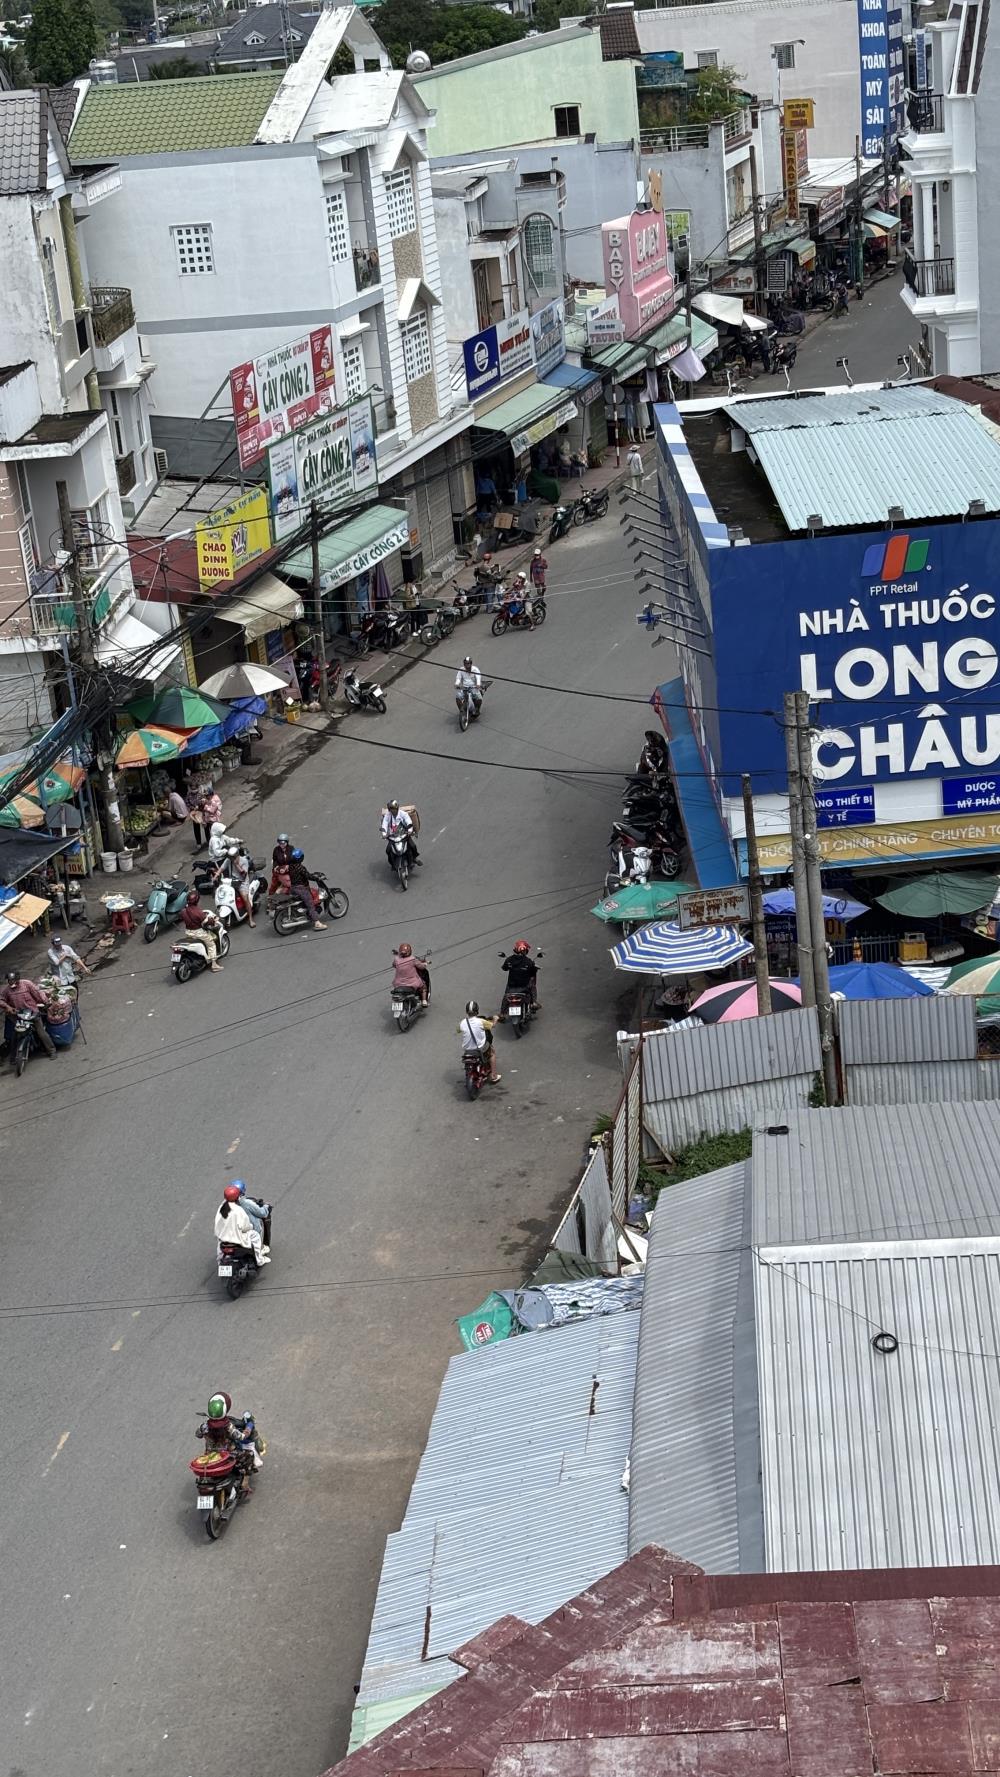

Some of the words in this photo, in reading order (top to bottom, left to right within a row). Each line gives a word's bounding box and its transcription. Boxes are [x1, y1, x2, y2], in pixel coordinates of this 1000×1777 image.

[861, 22, 885, 37] KHOA
[866, 105, 884, 125] SÀI
[608, 231, 624, 292] BABY
[262, 371, 279, 414] CÂY
[280, 363, 304, 404] CÒNG
[303, 362, 310, 393] 2
[303, 449, 319, 491] CÂY
[320, 437, 345, 479] CÒNG
[345, 438, 351, 469] 2
[353, 553, 370, 571] CÂY
[370, 537, 396, 560] CÒNG
[392, 533, 402, 544] 2
[870, 585, 887, 596] FPT
[891, 582, 918, 594] Retail
[800, 598, 870, 637] NHÀ
[879, 583, 996, 629] THUỐC
[800, 637, 998, 704] LONG
[812, 703, 1000, 781] CHÂU
[836, 794, 860, 806] THIẾT
[863, 795, 872, 805] BỊ
[965, 781, 996, 792] DƯỢC
[957, 797, 973, 809] MỸ
[931, 824, 985, 841] CHUYÊN
